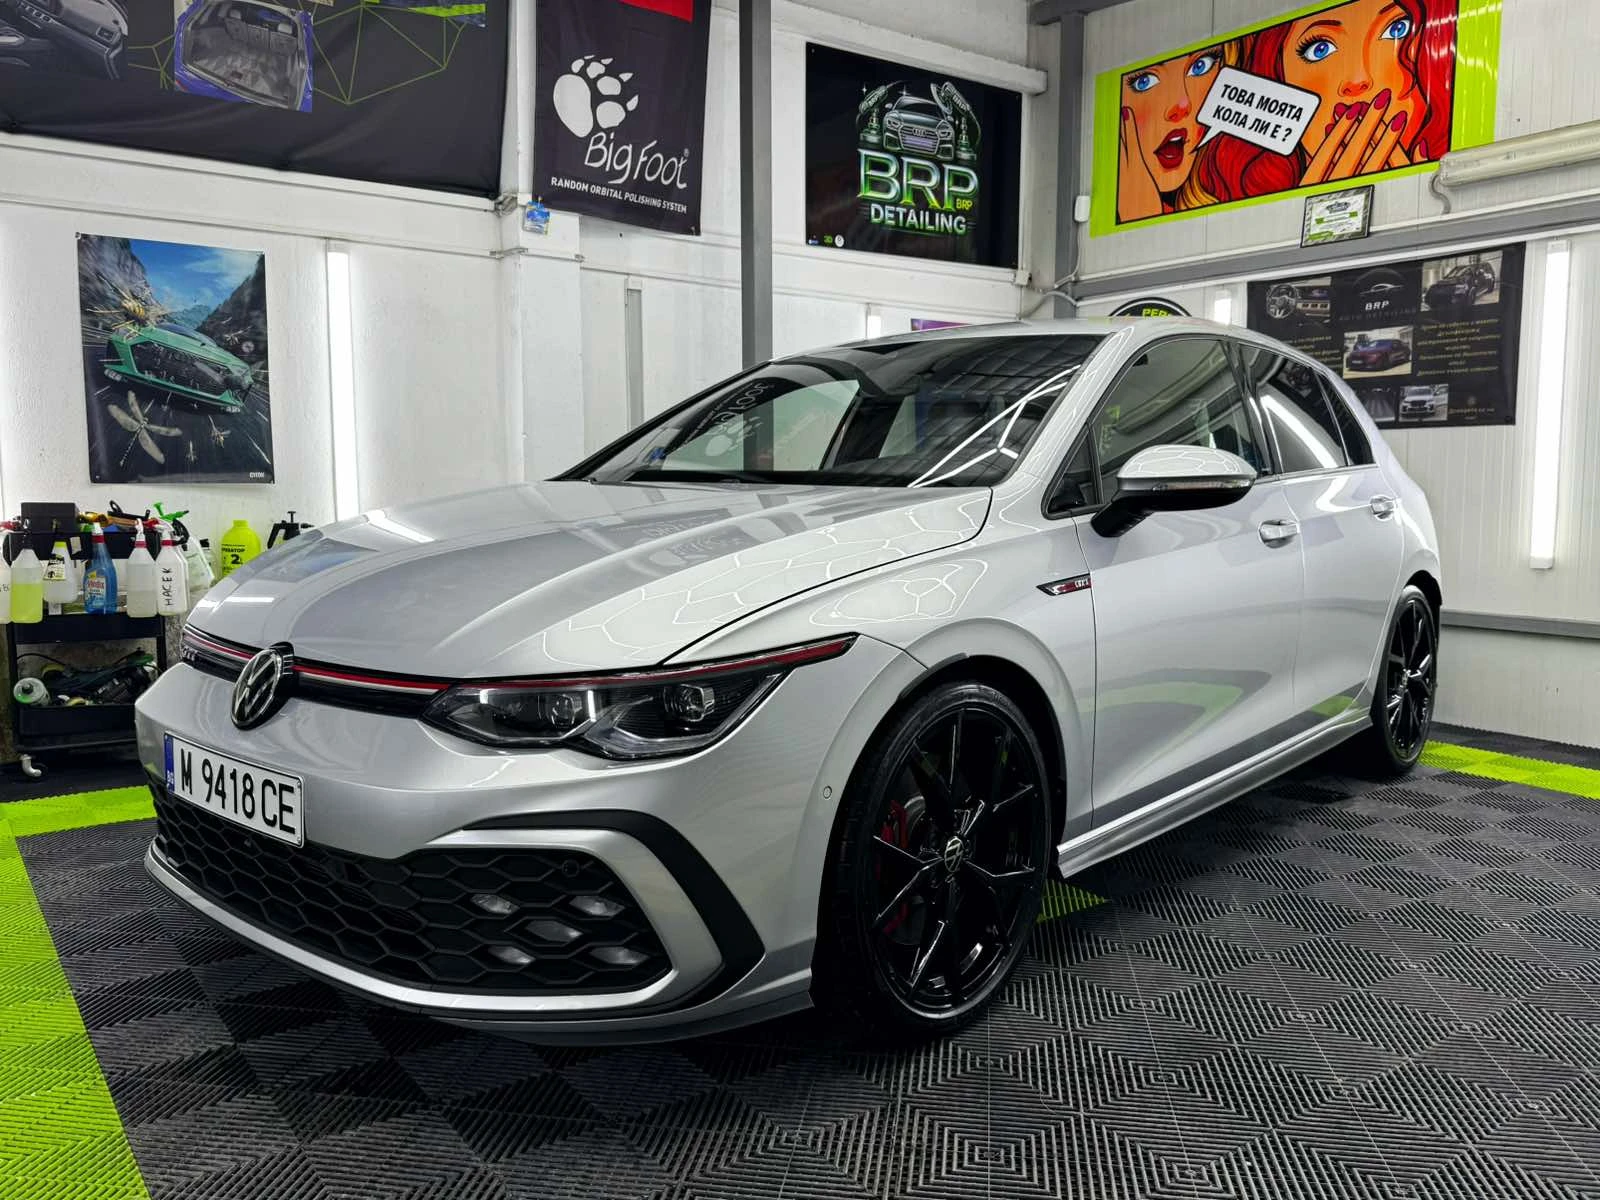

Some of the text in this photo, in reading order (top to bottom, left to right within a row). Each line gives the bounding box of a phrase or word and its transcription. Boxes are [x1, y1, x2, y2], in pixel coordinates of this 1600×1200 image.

[1221, 84, 1304, 122] ТОВА МОЯТА
[1212, 105, 1292, 142] КОЛА ЛИ Е ?
[551, 176, 687, 214] RANDOM ORBITAL POLISHING SYSTEM
[856, 148, 979, 212] BRP
[870, 203, 967, 234] DETAILING
[956, 198, 973, 211] BRP
[1364, 300, 1390, 311] BRP
[180, 747, 296, 835] M 9418 CE
